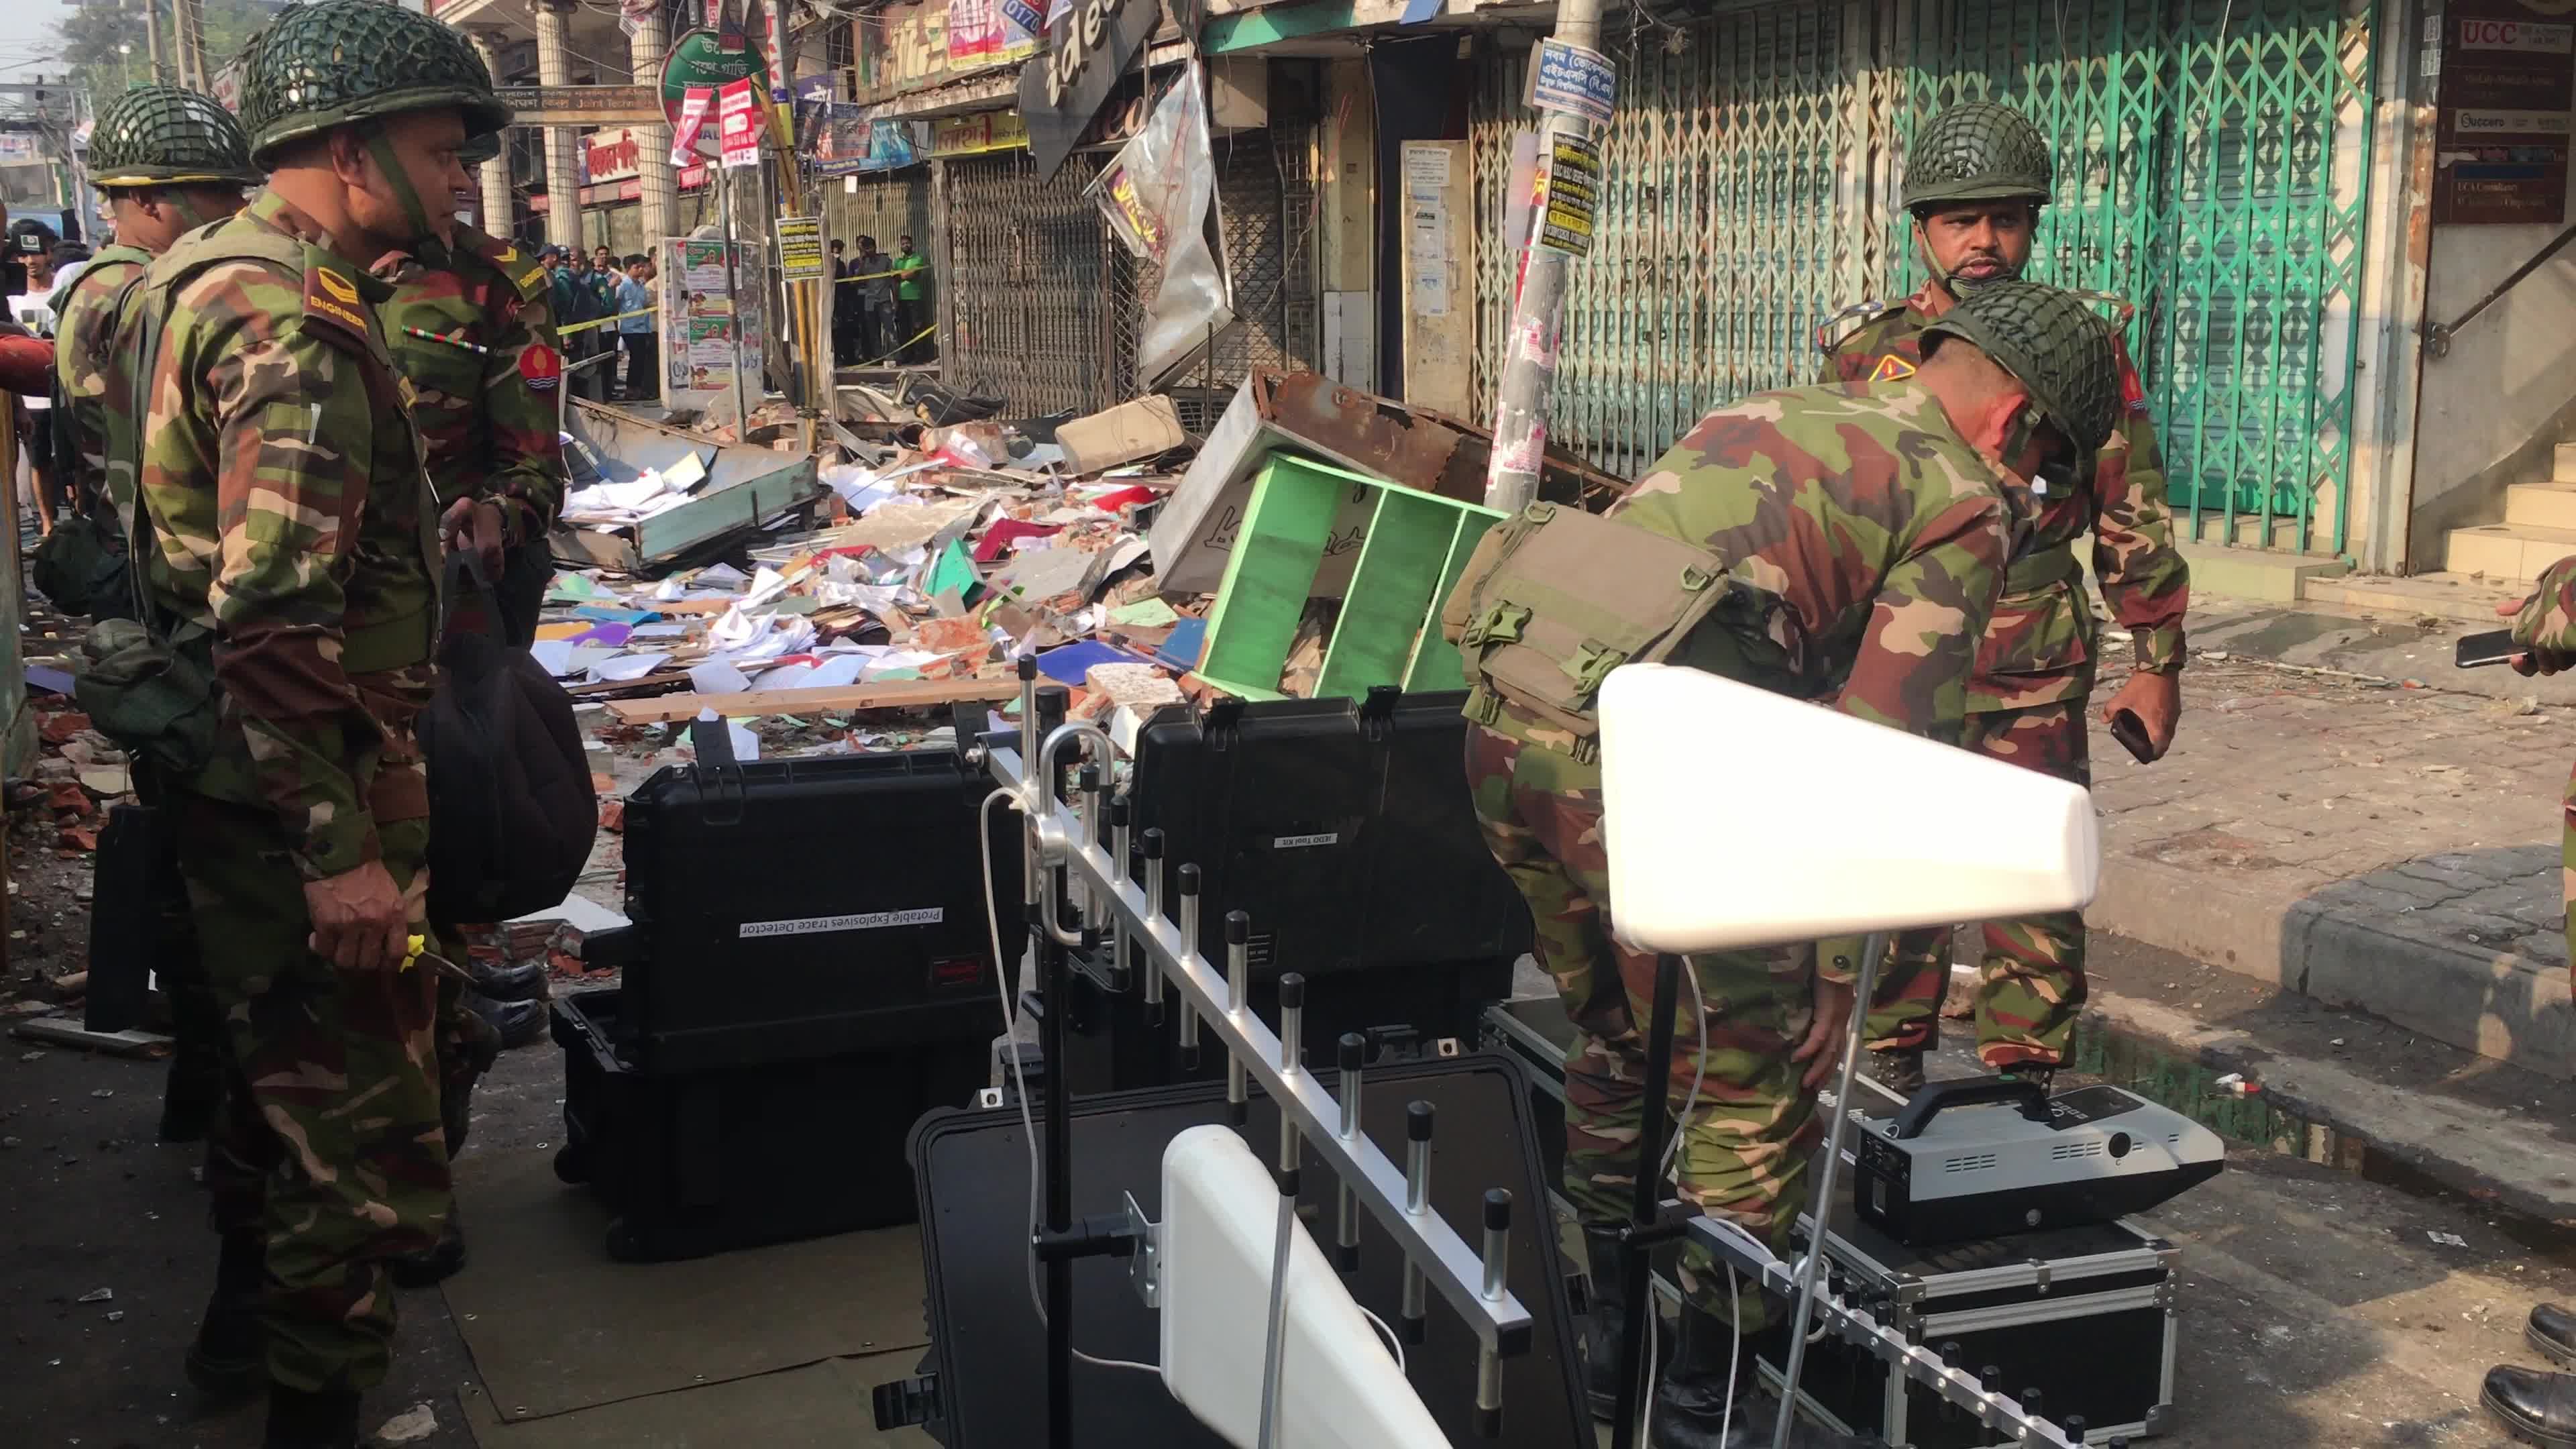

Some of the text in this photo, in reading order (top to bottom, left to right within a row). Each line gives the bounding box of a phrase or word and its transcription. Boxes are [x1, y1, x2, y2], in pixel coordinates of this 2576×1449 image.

[2463, 21, 2518, 44] UCC
[742, 911, 940, 934] Protable Explosives trace Detector
